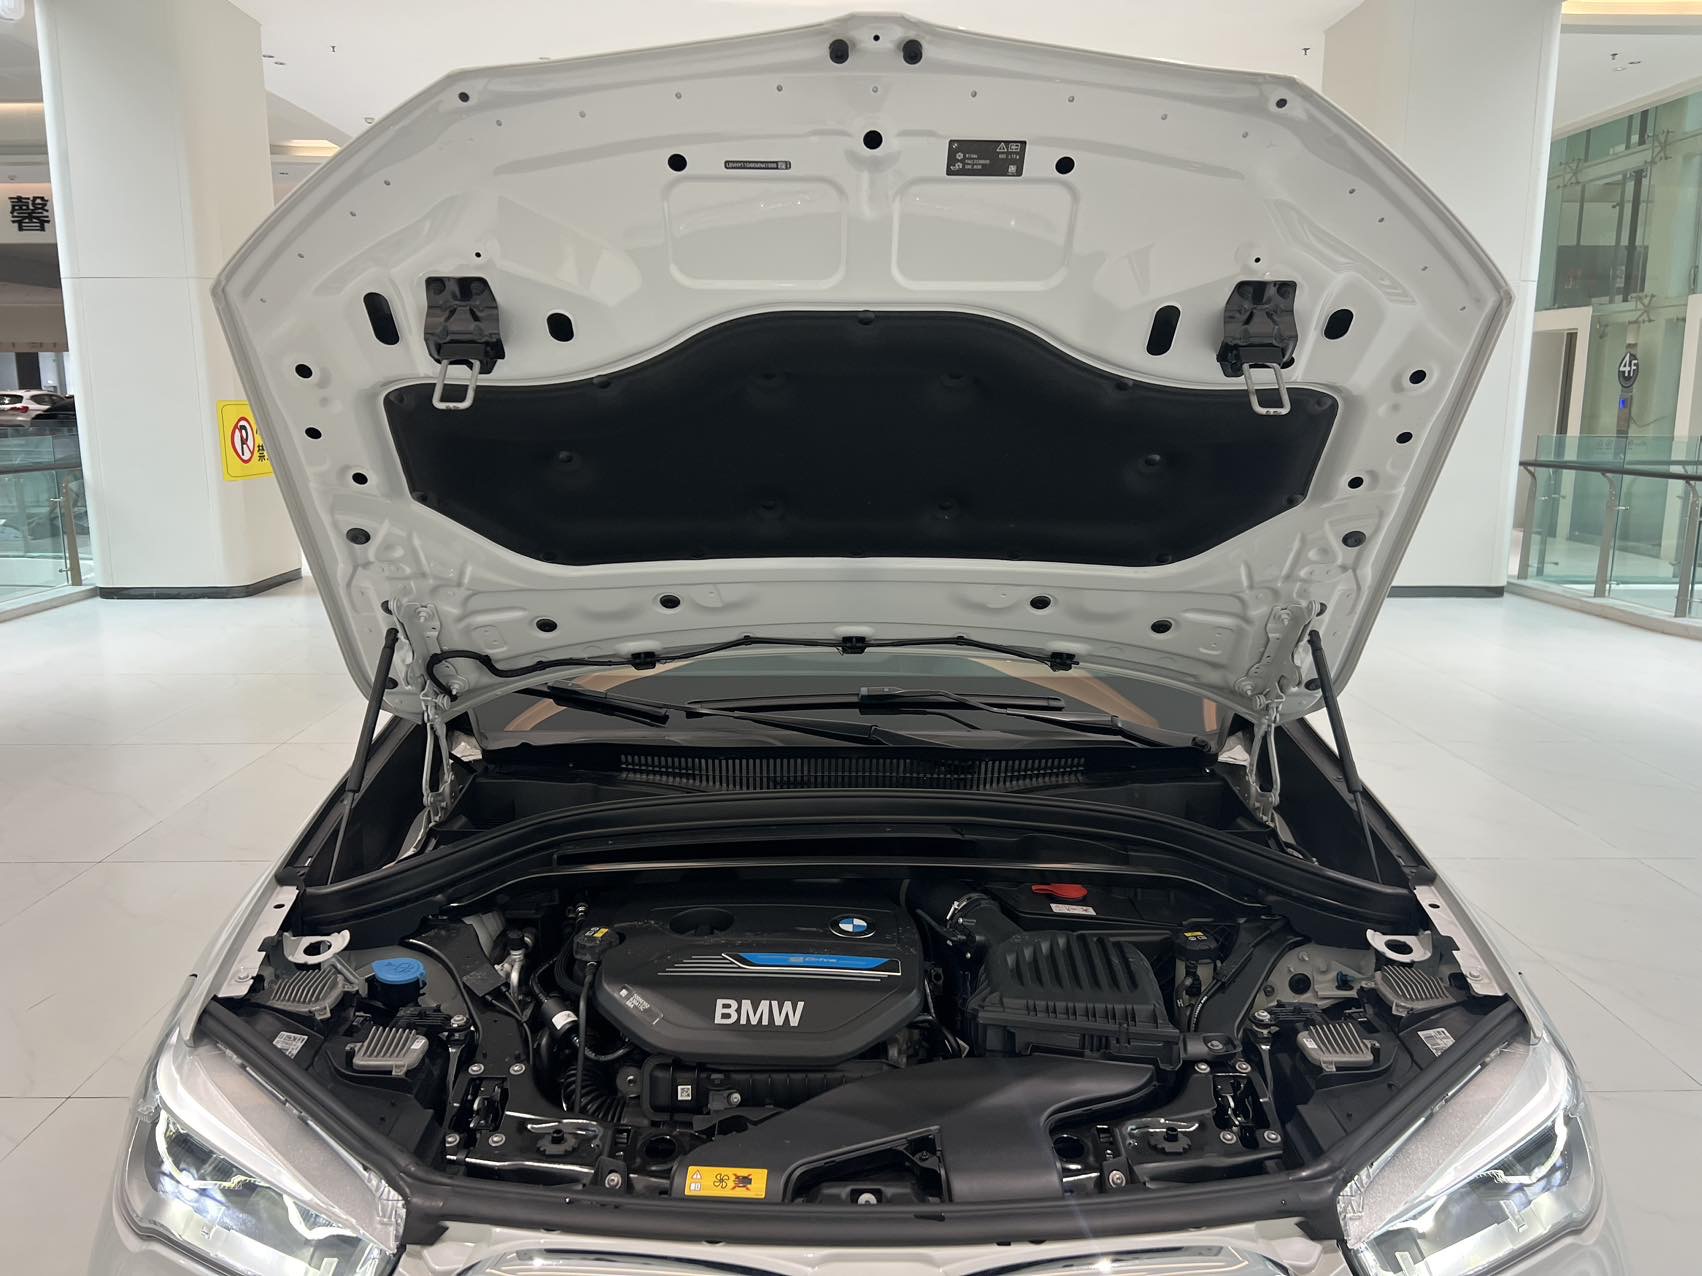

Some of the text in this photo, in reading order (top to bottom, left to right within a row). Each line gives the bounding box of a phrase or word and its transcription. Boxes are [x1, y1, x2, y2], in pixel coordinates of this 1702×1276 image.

[8, 195, 50, 232] 馨
[1619, 352, 1638, 377] 4F
[714, 998, 805, 1027] BMW
